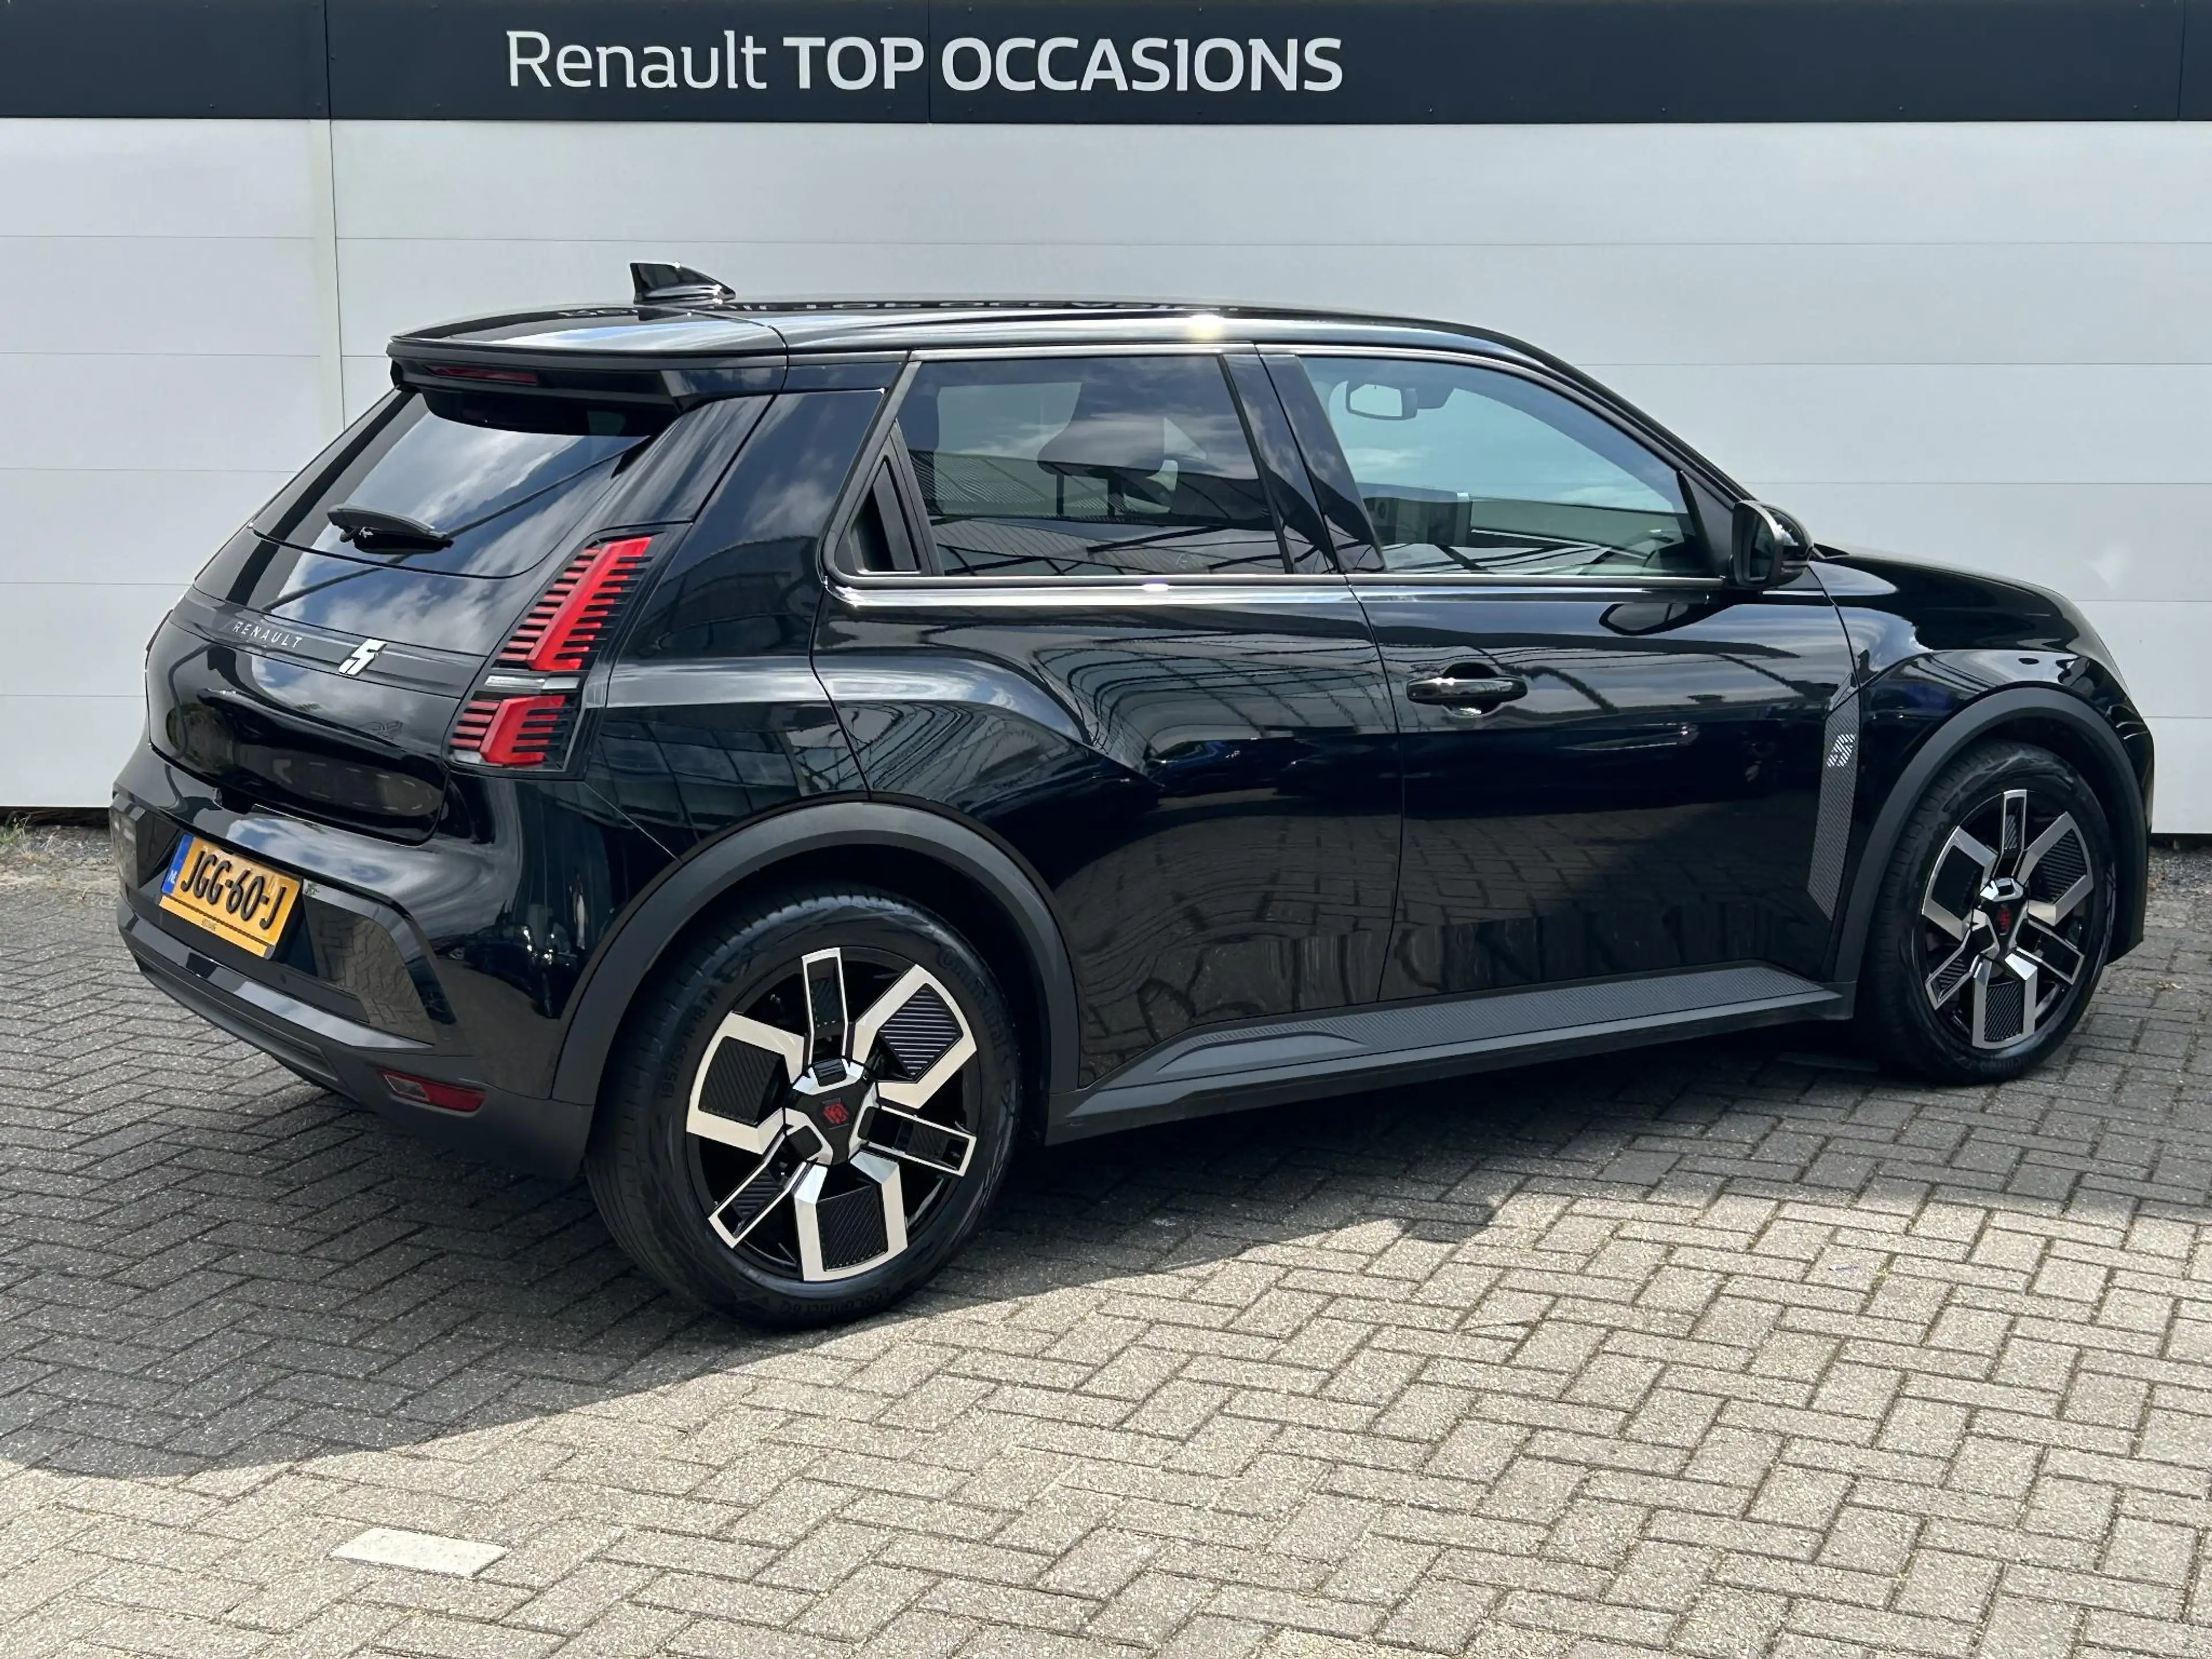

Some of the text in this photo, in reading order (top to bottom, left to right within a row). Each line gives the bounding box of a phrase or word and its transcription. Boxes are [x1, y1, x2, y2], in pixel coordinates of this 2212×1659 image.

[506, 30, 1343, 91] Renault TOP OCCASIONS
[232, 621, 303, 648] RENAULT
[180, 850, 287, 930] JGG-60-J
